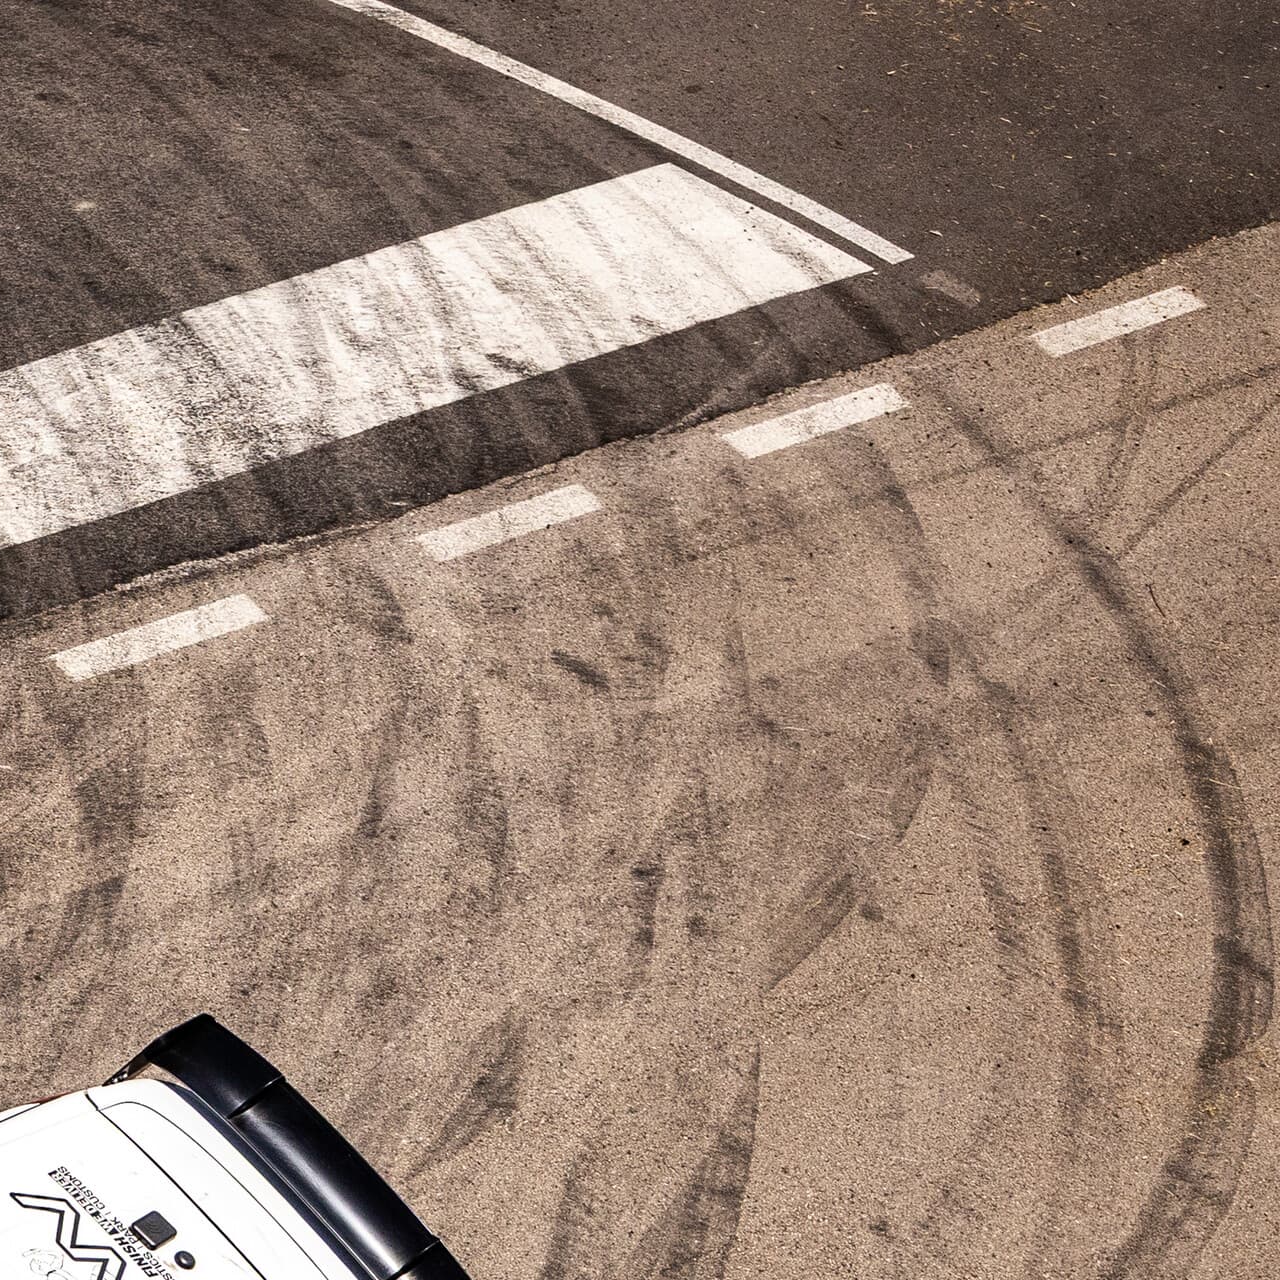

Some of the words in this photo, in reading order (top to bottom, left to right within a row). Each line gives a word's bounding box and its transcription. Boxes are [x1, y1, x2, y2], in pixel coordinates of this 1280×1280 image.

[47, 1169, 99, 1216] DELIVER
[57, 1164, 106, 1210] CUSTOMS
[109, 1215, 138, 1244] PARK
[113, 1234, 156, 1276] FINISH
